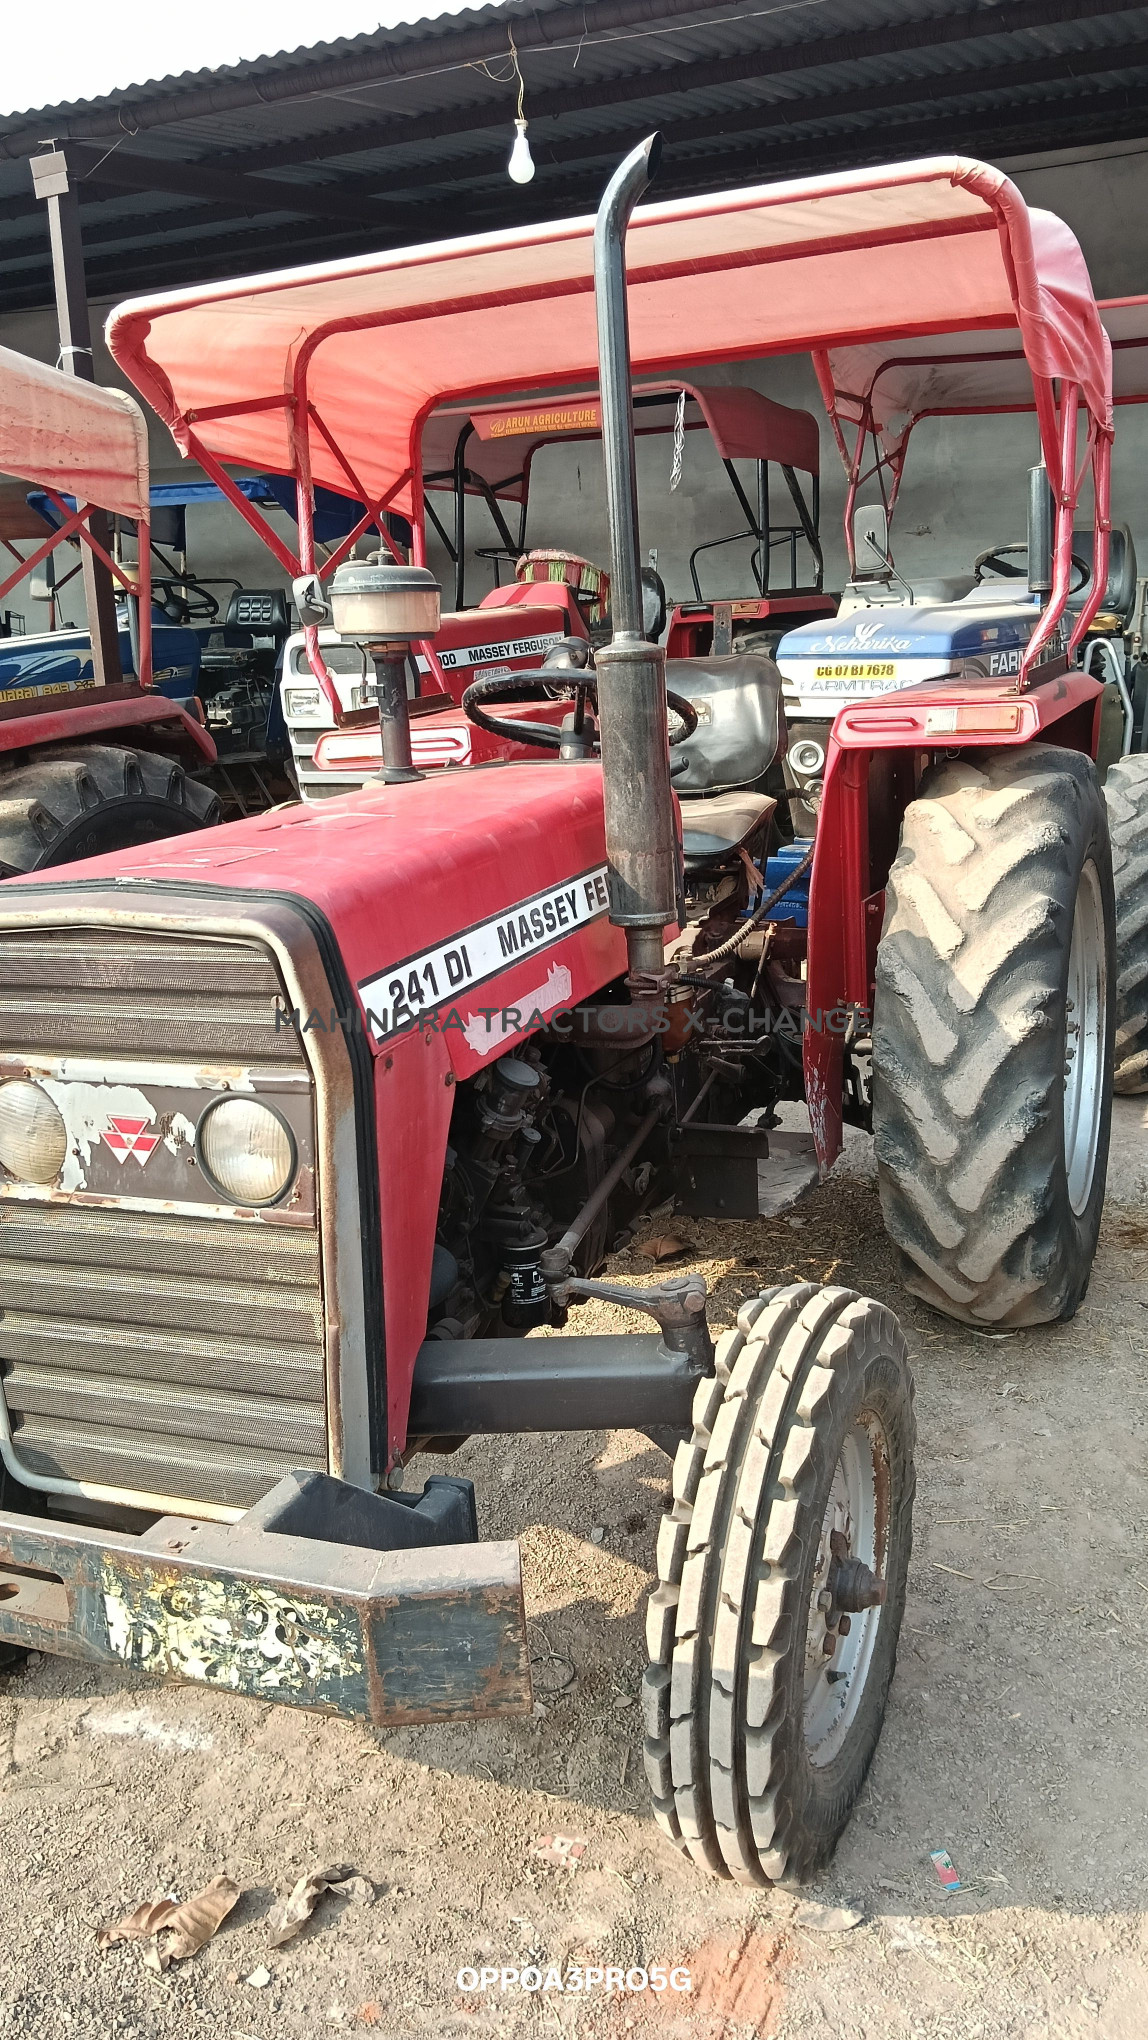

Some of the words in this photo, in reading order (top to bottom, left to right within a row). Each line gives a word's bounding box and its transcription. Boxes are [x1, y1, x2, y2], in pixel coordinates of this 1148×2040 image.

[506, 415, 530, 427] ARUN
[532, 409, 597, 426] AGRICULTURE
[468, 644, 510, 662] MASSEY
[817, 666, 832, 676] CG
[835, 665, 848, 676] 07
[851, 665, 863, 676] BJ
[866, 664, 894, 676] 7678
[43, 682, 70, 696] 843
[388, 962, 440, 1019] 241
[443, 945, 473, 987] DI
[496, 889, 579, 958] MASSEY
[583, 872, 610, 912] FE
